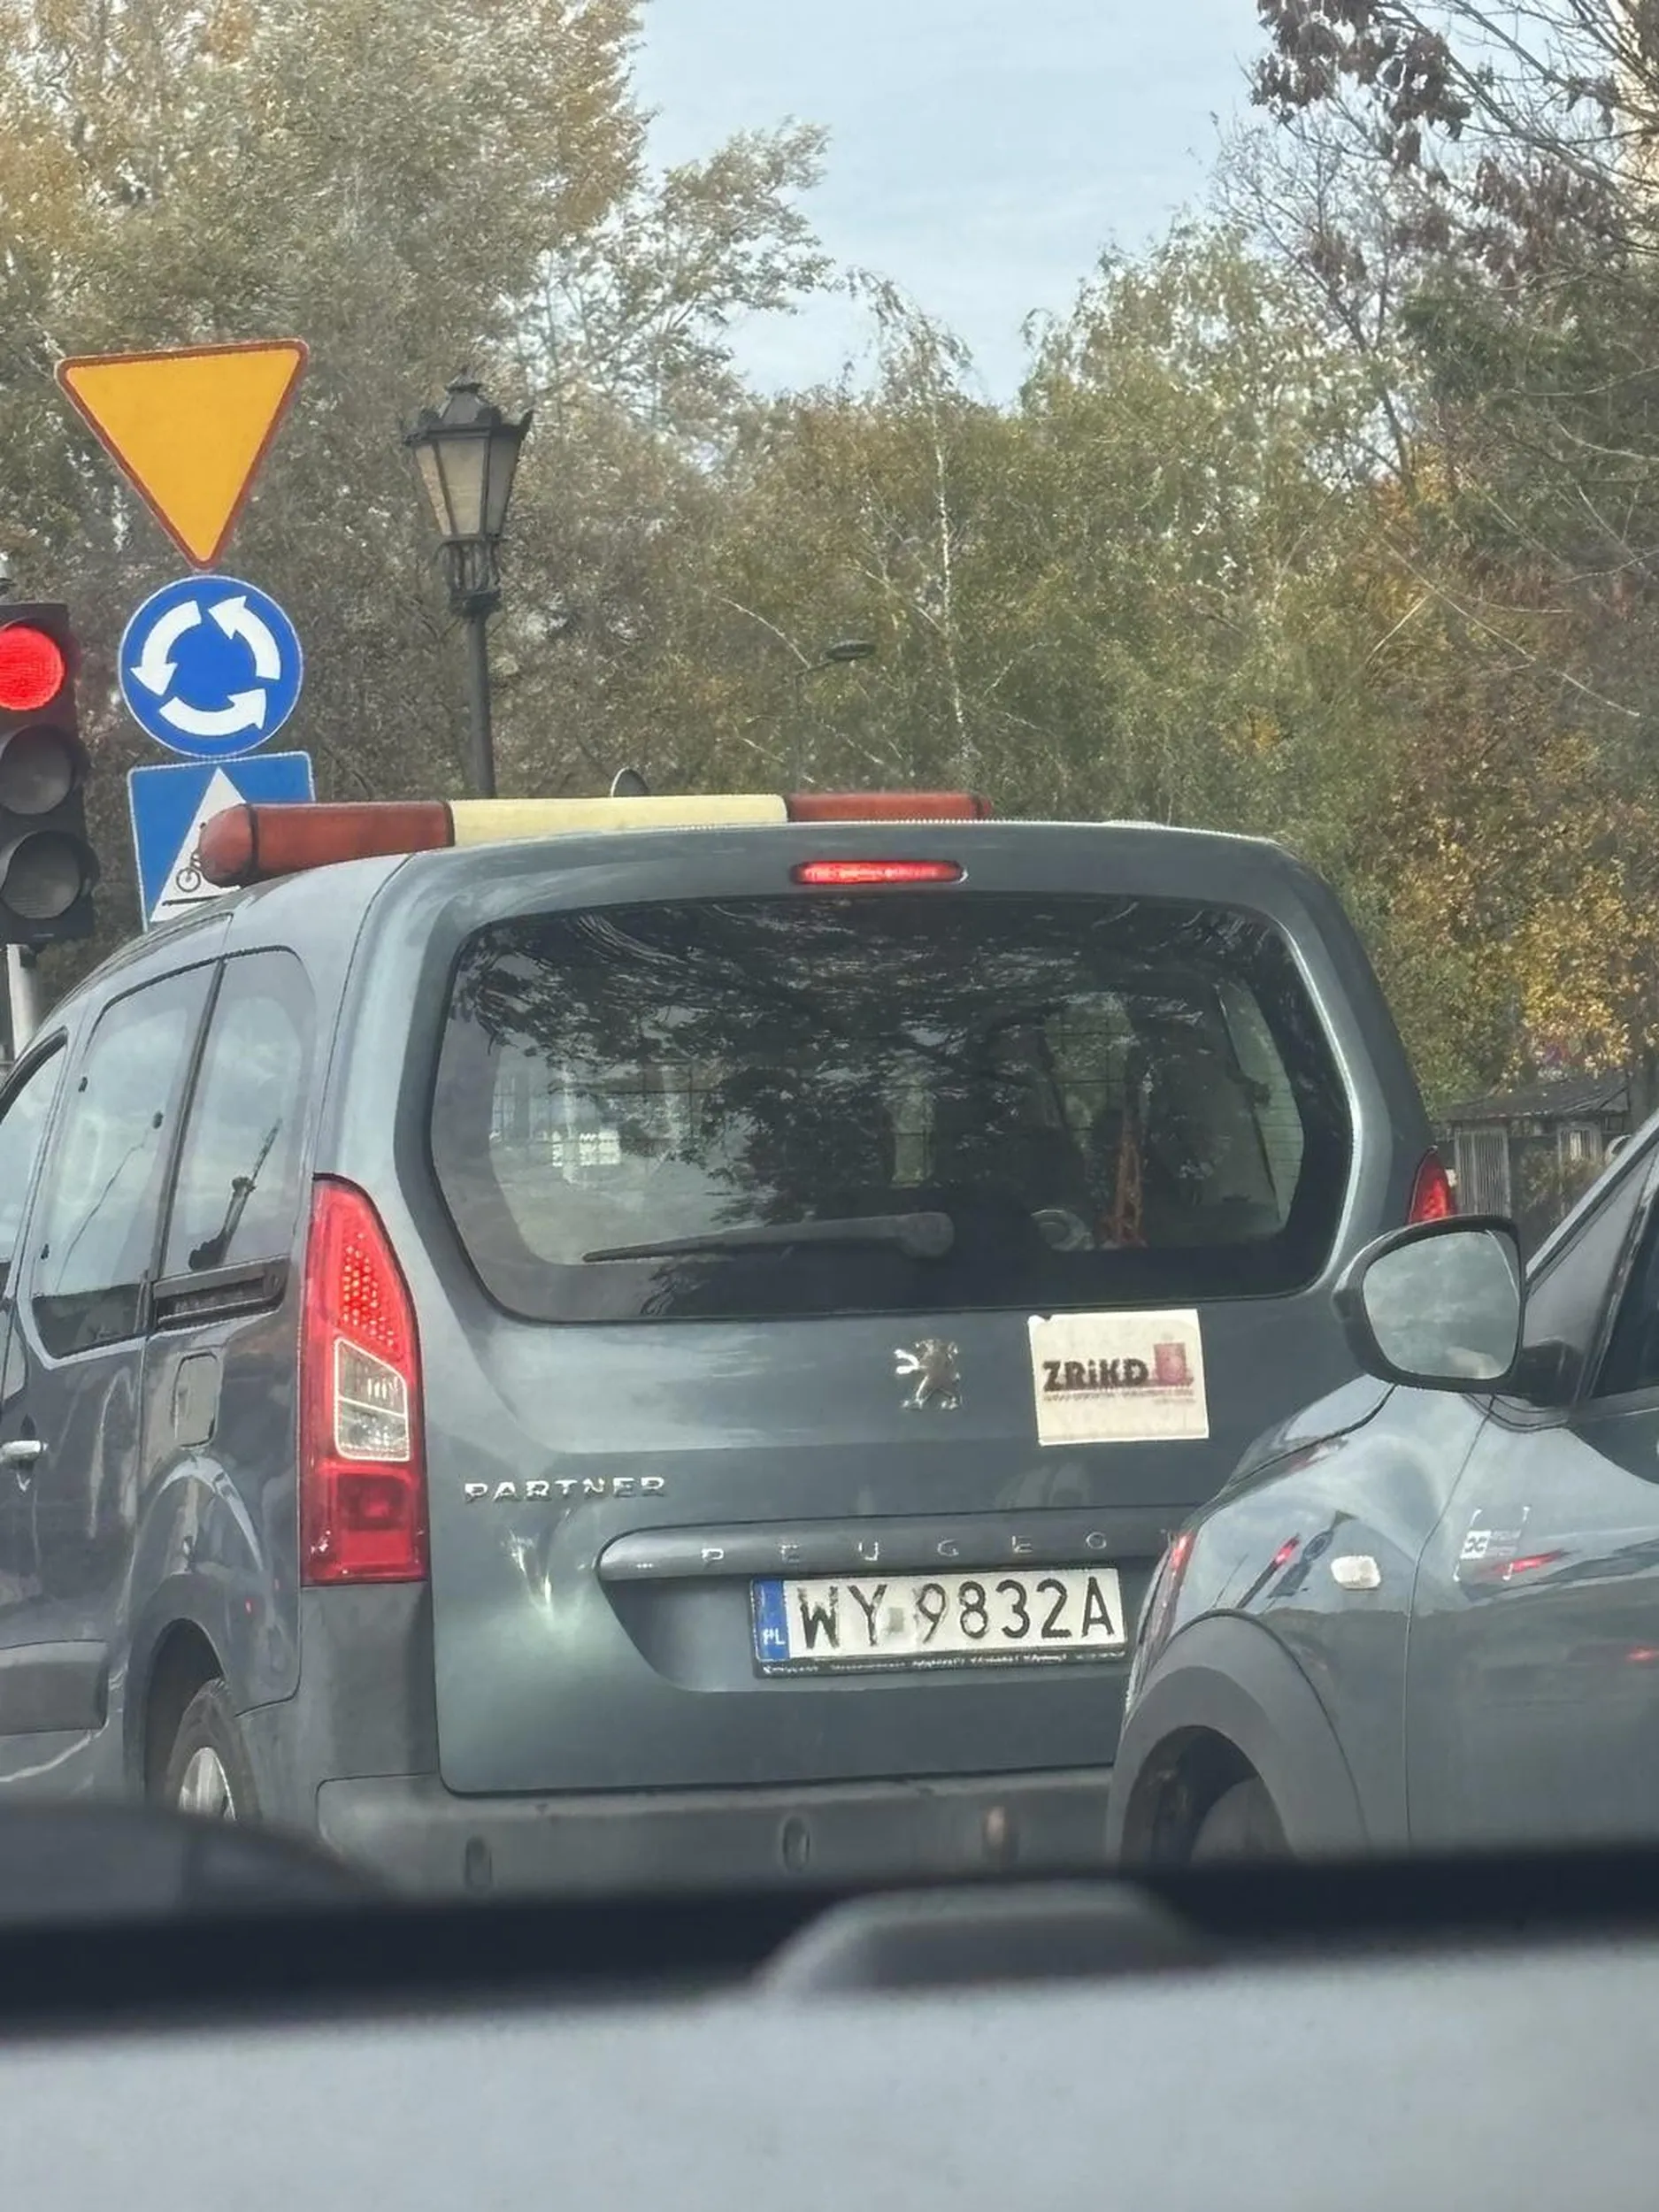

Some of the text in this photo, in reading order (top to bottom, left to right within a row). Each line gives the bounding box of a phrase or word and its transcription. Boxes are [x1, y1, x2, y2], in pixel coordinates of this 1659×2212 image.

[465, 1477, 666, 1502] PARTNER
[701, 1530, 1166, 1568] PEUGEO
[797, 1576, 1115, 1648] WY 9832A
[763, 1628, 786, 1646] PL
